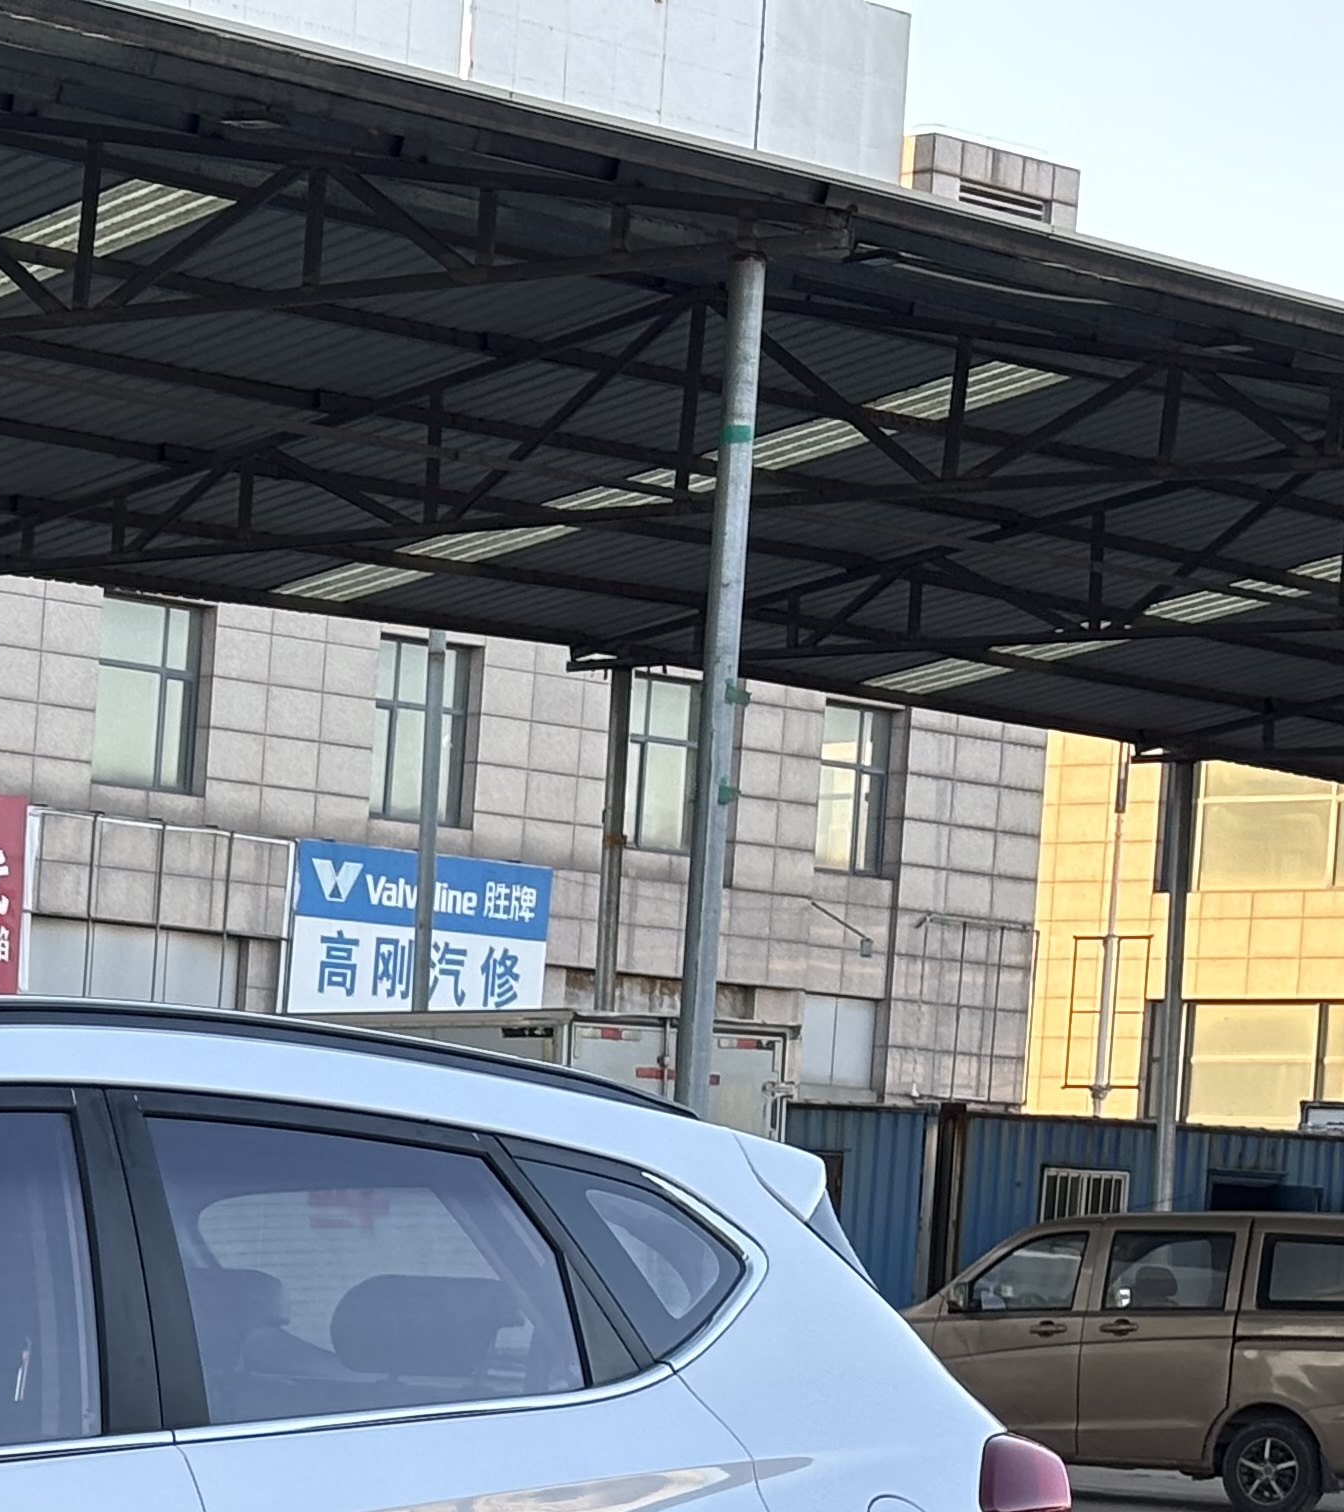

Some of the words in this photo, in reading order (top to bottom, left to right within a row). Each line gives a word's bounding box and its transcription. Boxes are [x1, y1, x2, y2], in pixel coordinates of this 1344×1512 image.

[365, 873, 478, 917] Valvline
[483, 881, 538, 923] 胜牌
[317, 929, 521, 1009] 高刚汽修
